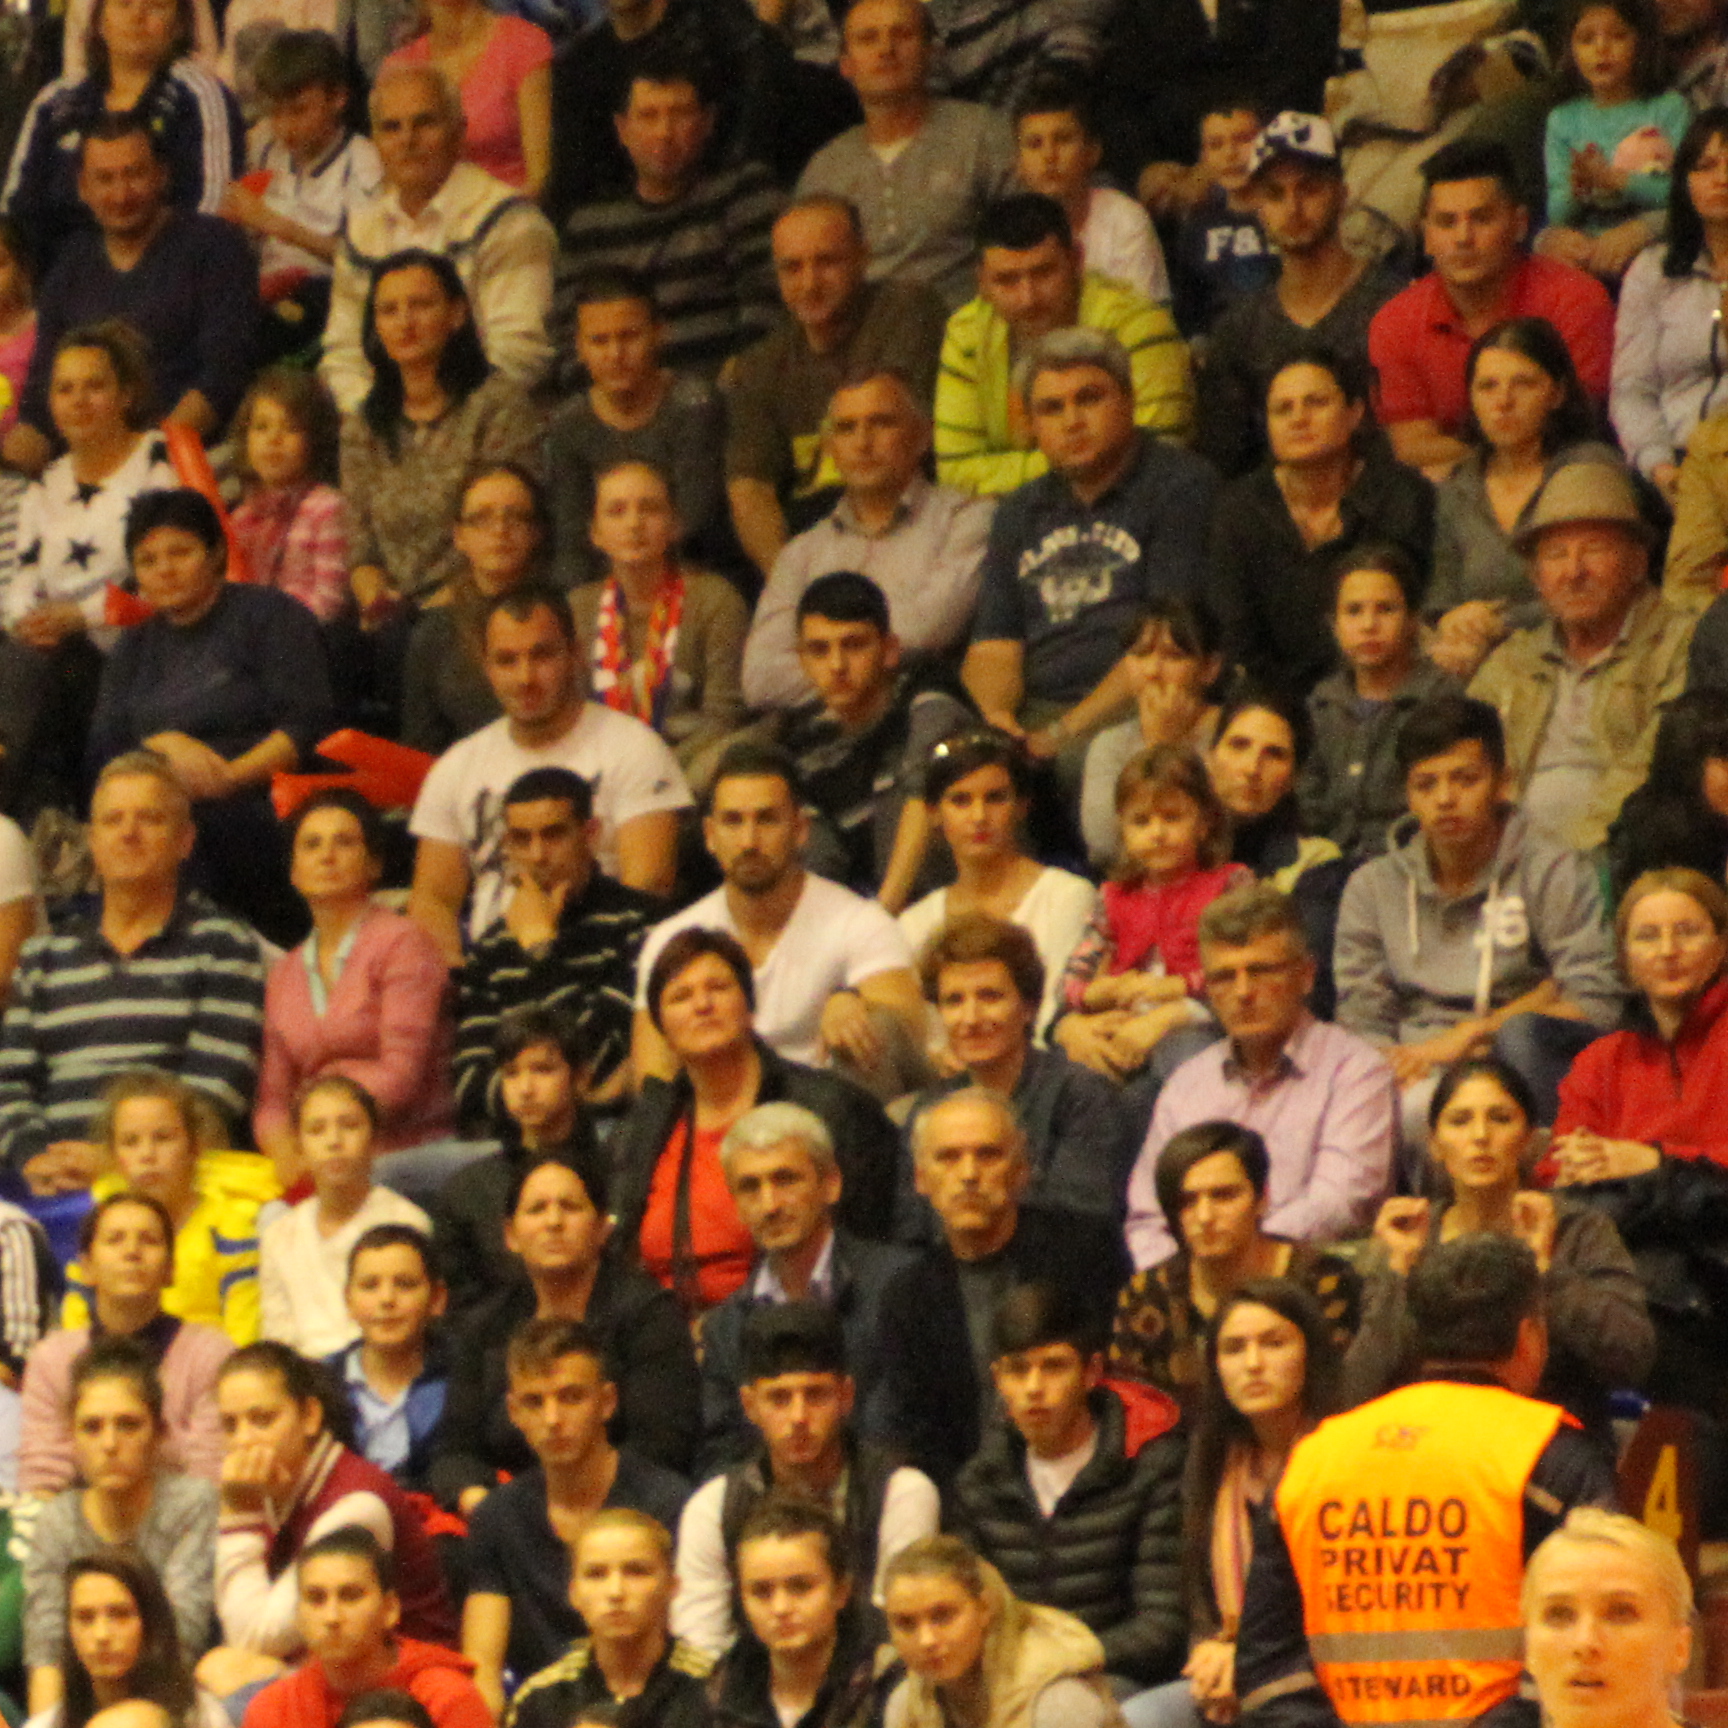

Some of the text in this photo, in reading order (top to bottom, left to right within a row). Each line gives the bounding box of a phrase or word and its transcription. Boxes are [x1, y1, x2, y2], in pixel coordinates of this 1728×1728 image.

[1645, 1444, 1682, 1548] 4
[1318, 1498, 1468, 1541] CALDO
[1321, 1546, 1470, 1576] PRIVAT
